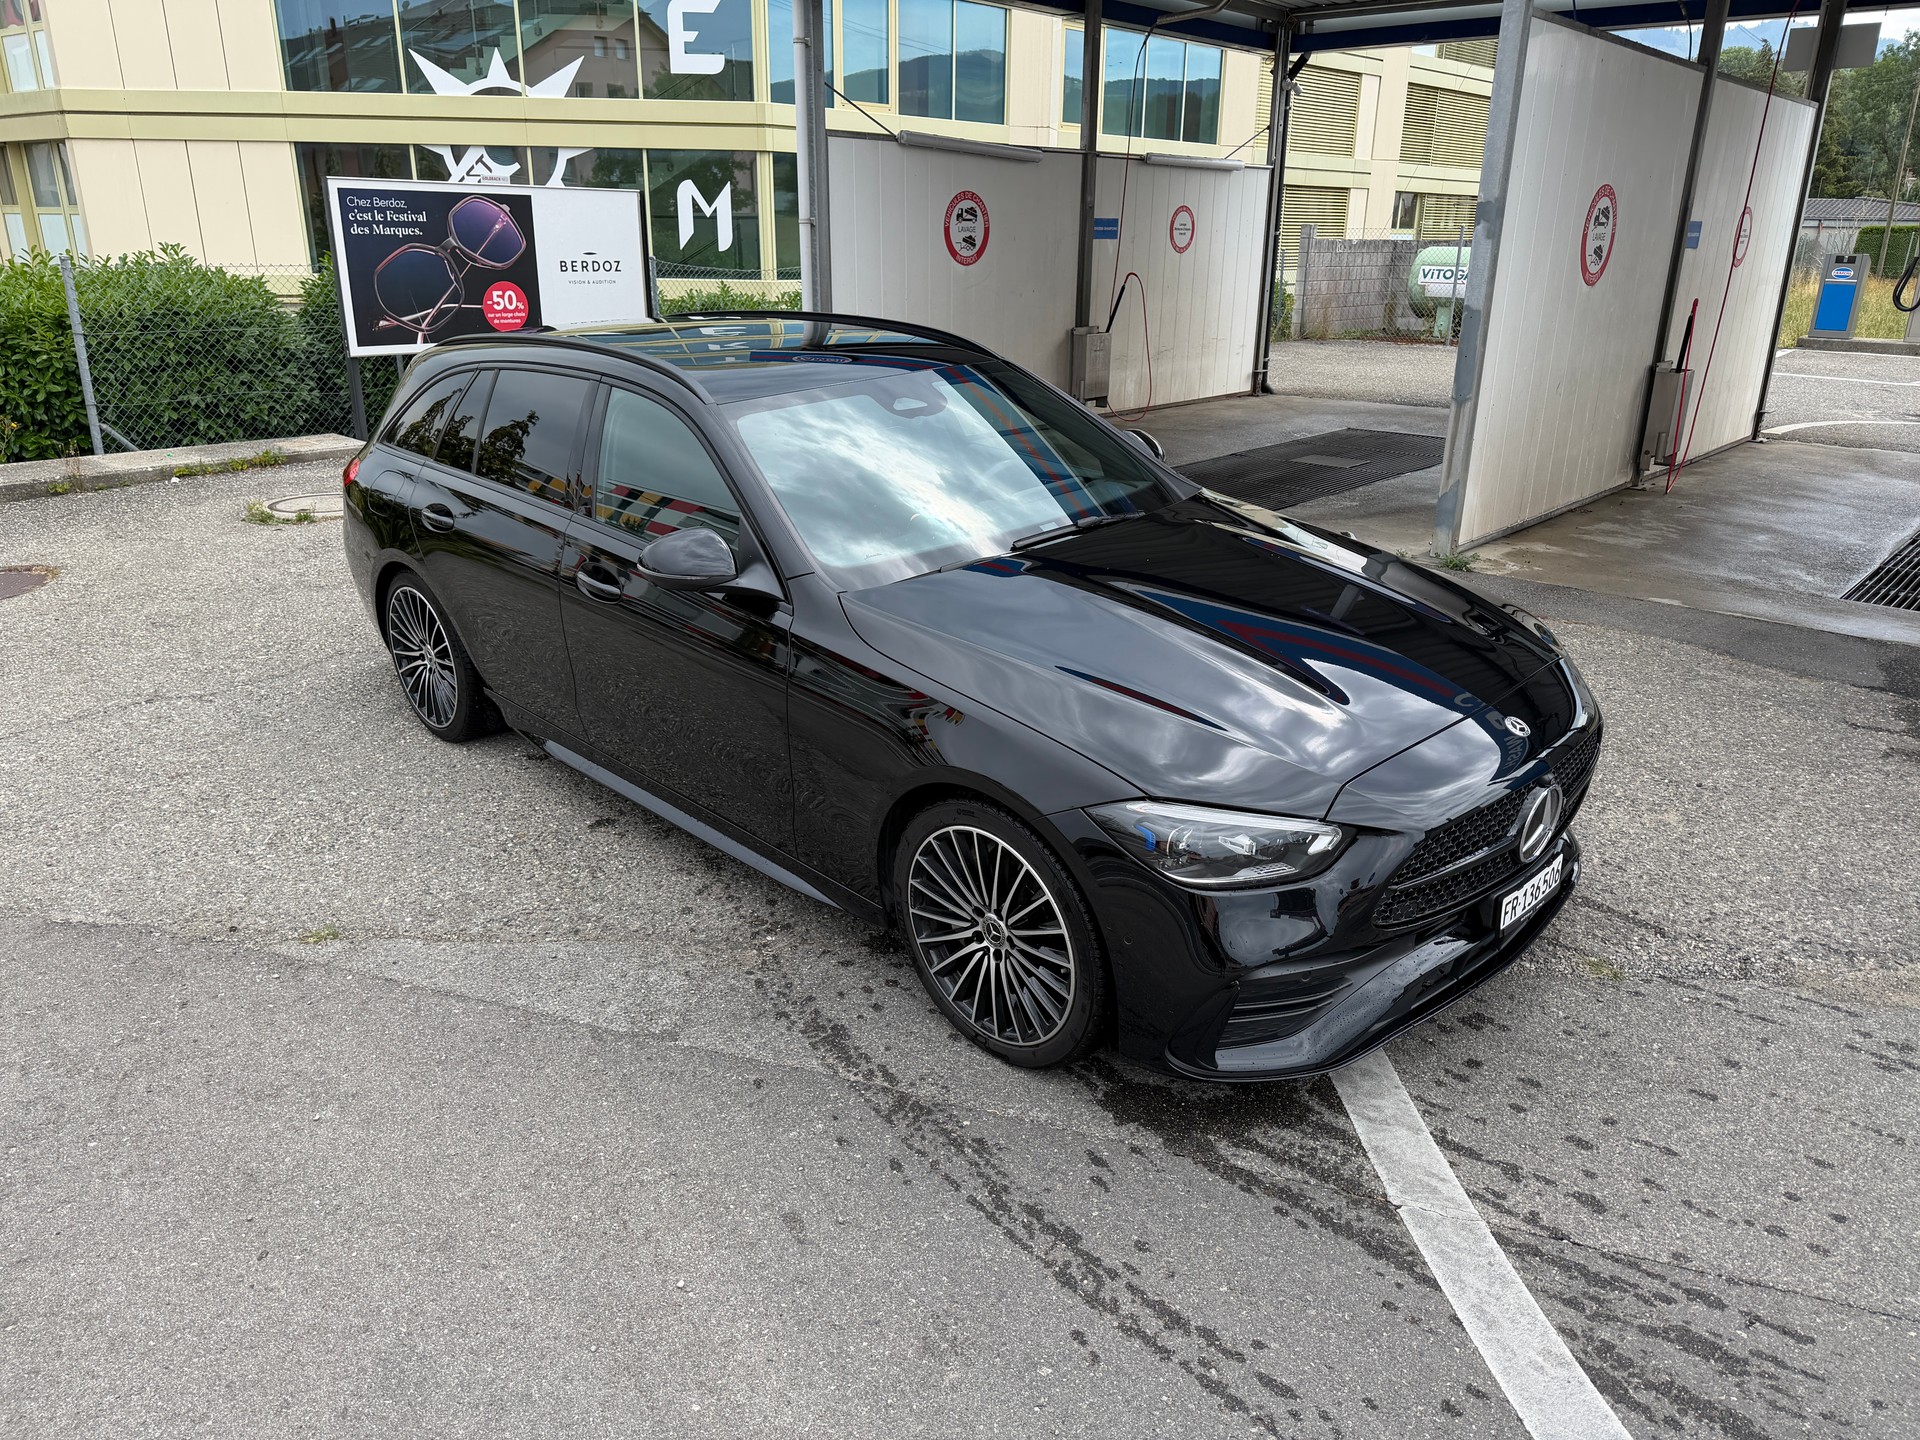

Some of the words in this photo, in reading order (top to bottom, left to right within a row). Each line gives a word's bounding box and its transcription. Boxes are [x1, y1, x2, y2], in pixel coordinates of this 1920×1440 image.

[346, 196, 372, 207] Chez
[373, 197, 407, 208] Berdoz,
[374, 210, 384, 220] le
[387, 211, 427, 222] Festival
[677, 179, 734, 252] M
[351, 223, 370, 235] des
[373, 224, 423, 238] Marques.
[559, 260, 622, 272] BERDOZ
